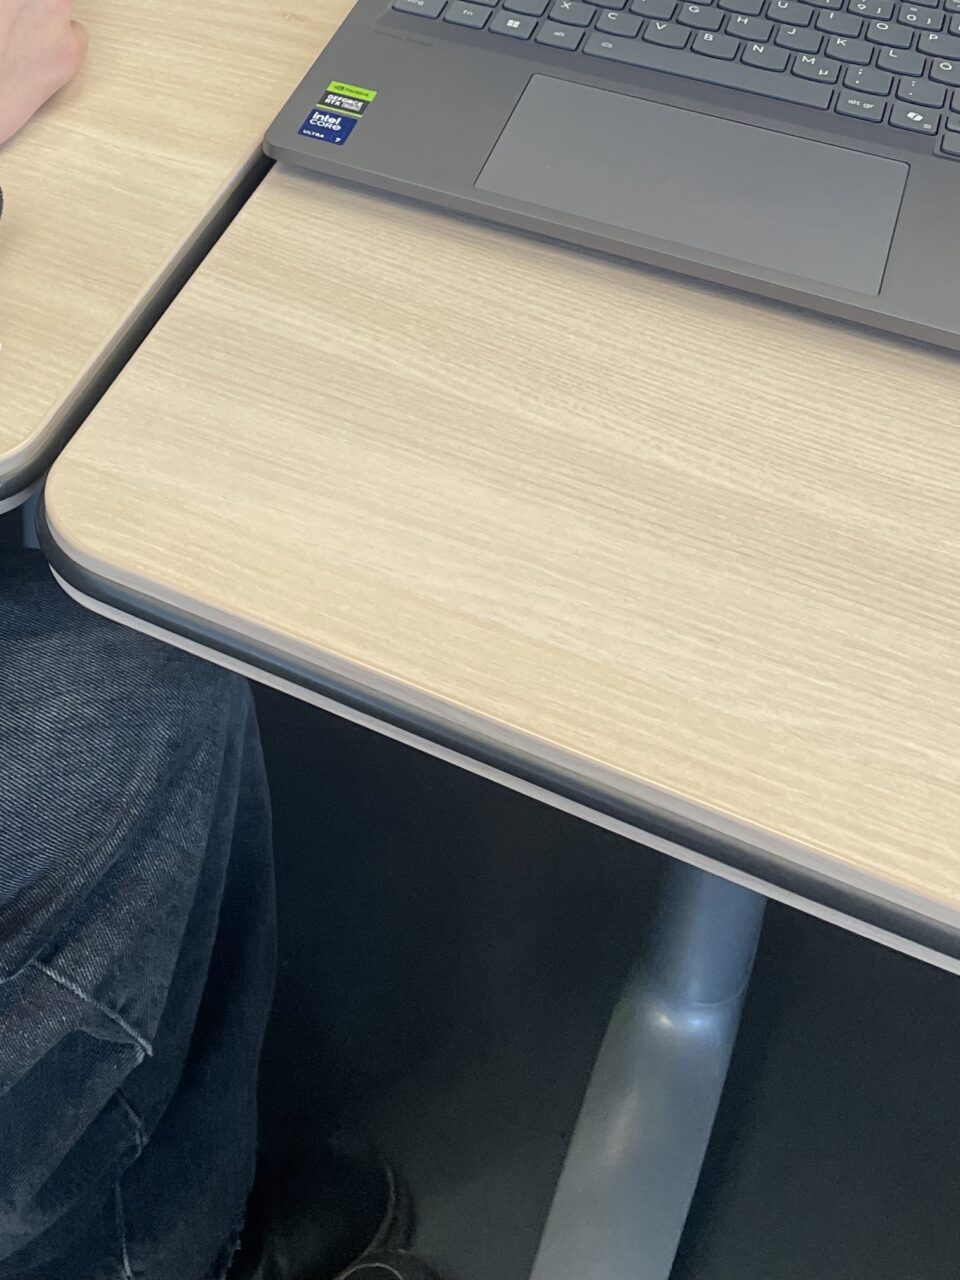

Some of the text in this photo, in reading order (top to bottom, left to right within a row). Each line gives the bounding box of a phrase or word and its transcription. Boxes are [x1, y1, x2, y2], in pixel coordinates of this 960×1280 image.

[561, 1, 572, 9] X
[688, 5, 700, 13] G
[777, 0, 788, 9] U
[608, 12, 618, 20] C
[737, 16, 748, 25] H
[656, 22, 667, 30] V
[703, 33, 713, 41] B
[836, 38, 847, 46] K
[752, 44, 764, 53] N
[889, 49, 898, 58] L
[801, 55, 815, 64] M
[324, 98, 341, 107] RTX
[327, 94, 364, 107] GEFORCE
[302, 129, 325, 139] ULTRA
